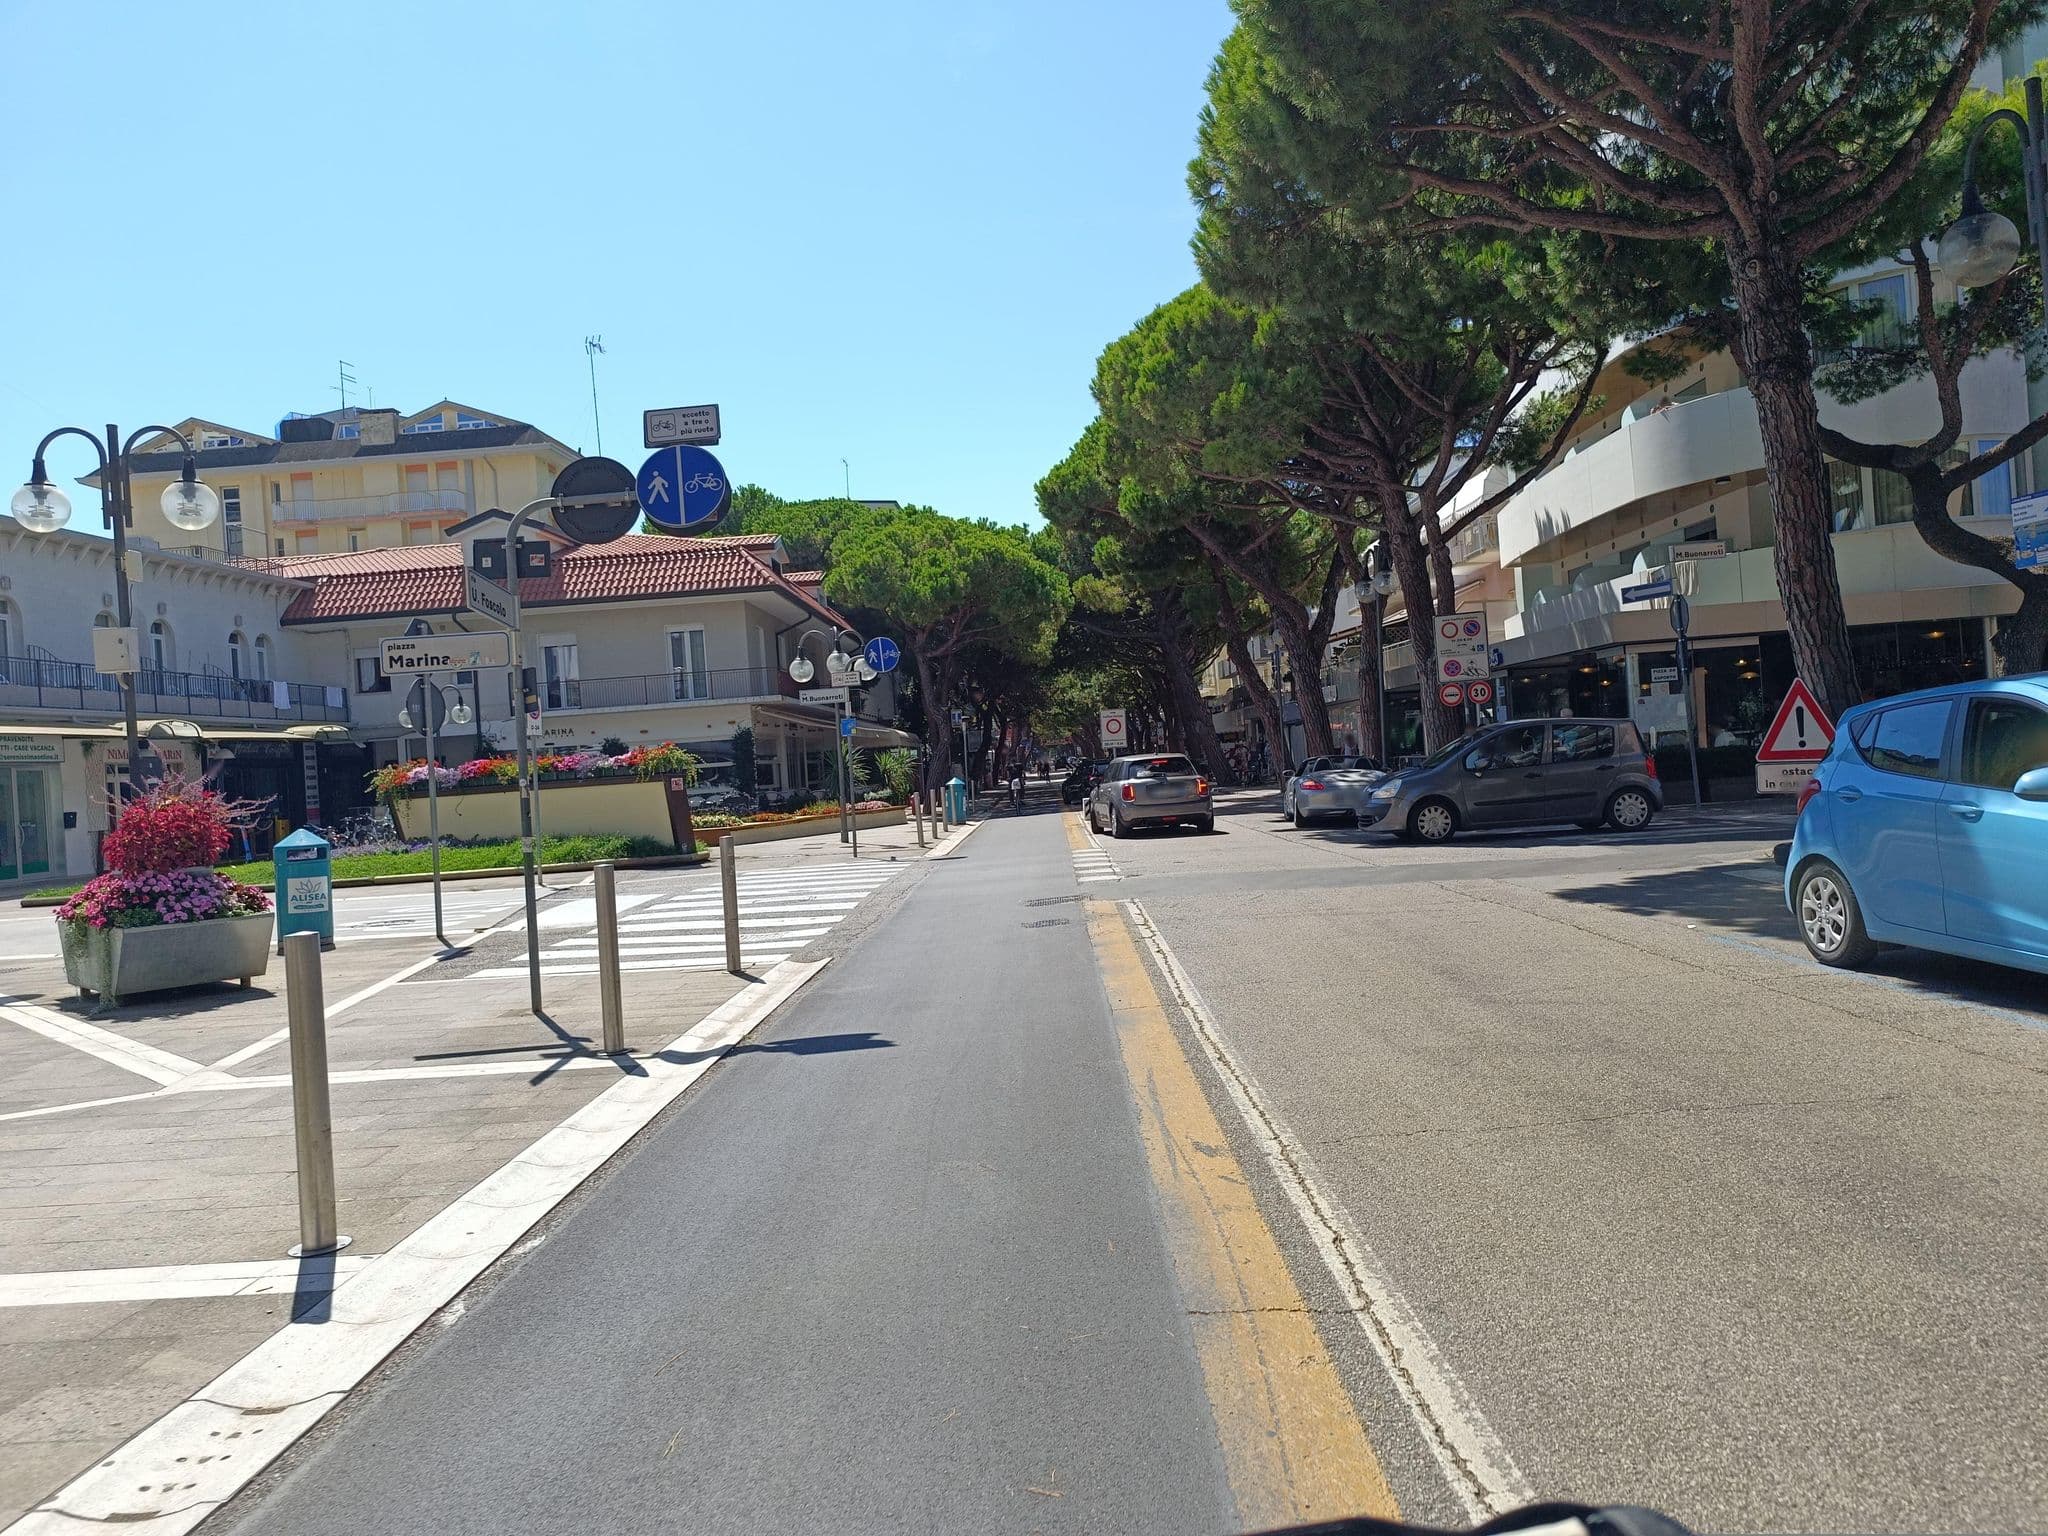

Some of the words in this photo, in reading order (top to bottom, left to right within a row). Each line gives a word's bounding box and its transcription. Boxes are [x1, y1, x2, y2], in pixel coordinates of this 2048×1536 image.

[472, 588, 480, 603] U.
[482, 593, 507, 618] Foscolo
[387, 643, 416, 651] piazza
[389, 653, 451, 668] Marina
[1473, 688, 1486, 697] 30
[543, 728, 575, 738] ARINA
[1765, 780, 1776, 788] in
[290, 893, 327, 902] ALISEA
